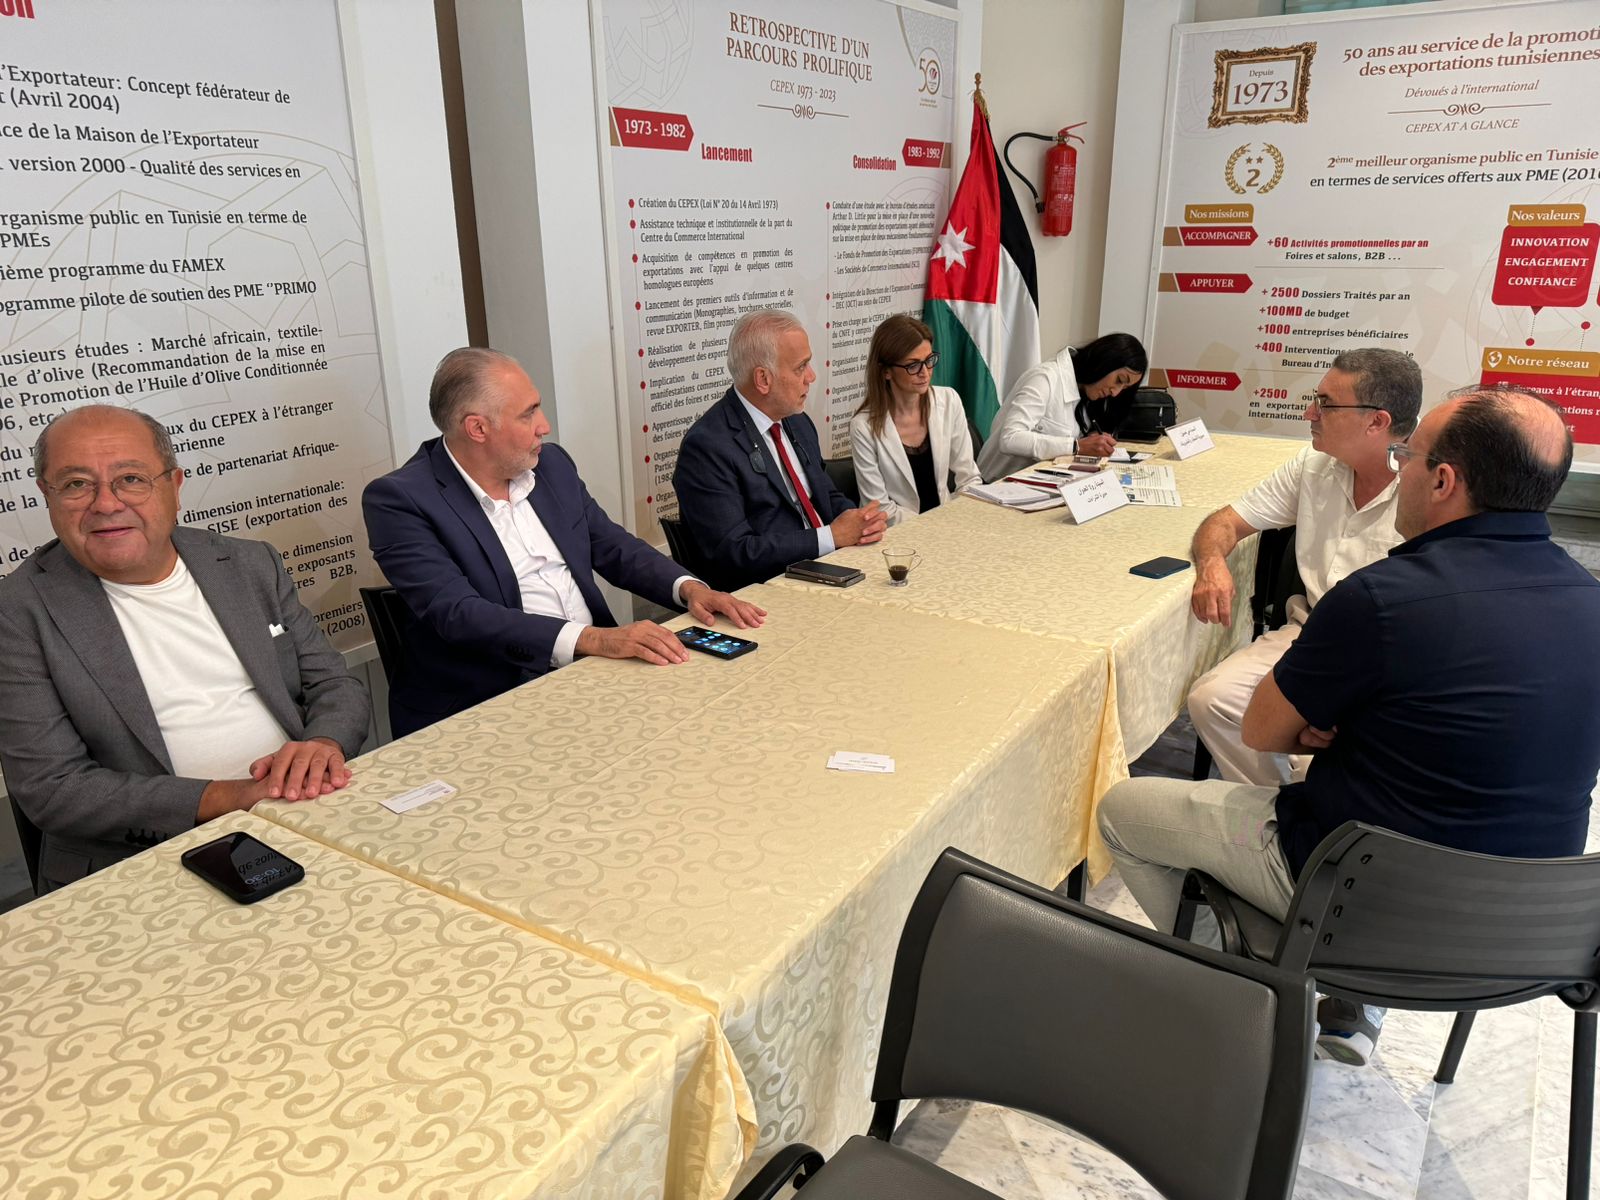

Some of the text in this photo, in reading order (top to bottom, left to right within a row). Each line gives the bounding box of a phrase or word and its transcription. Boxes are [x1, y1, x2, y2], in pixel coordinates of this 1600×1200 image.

[730, 11, 836, 52] RETROSPECTIVE
[1343, 47, 1363, 63] 50
[1367, 46, 1394, 58] ans
[1397, 44, 1417, 55] au
[1420, 36, 1479, 53] service
[1481, 32, 1503, 48] de
[1506, 31, 1522, 47] la
[726, 36, 872, 82] PARCOURS PROLIFIQUE
[1359, 48, 1600, 77] des exportations tunisiennes
[127, 76, 191, 98] Concept
[195, 81, 270, 102] fédérateur
[274, 89, 290, 103] de
[770, 79, 794, 94] CEPEX
[797, 84, 812, 99] 1973
[819, 88, 836, 103] 2023
[1233, 80, 1288, 105] 1973
[1404, 86, 1449, 98] Dévoués
[1450, 84, 1458, 95] à
[10, 86, 63, 108] (Avril
[66, 92, 119, 114] 2004)
[624, 118, 651, 135] 1973
[660, 122, 685, 138] 1982
[1405, 118, 1519, 133] CEPEX AT A GLANCE
[28, 122, 50, 139] de
[53, 123, 71, 140] la
[75, 125, 136, 143] Maison
[140, 128, 159, 144] de
[162, 129, 259, 150] l’Exportateur
[701, 142, 752, 162] Lancement
[907, 146, 923, 157] 1983
[927, 148, 941, 159] 1992
[1355, 155, 1408, 167] meilleur
[1409, 153, 1477, 168] organisme
[1479, 150, 1523, 166] public
[1525, 153, 1542, 161] en
[1546, 148, 1599, 160] Tunisie
[9, 156, 76, 172] version
[80, 157, 125, 173] 2000
[140, 159, 195, 177] Qualité
[199, 161, 223, 175] des
[227, 163, 282, 177] services
[285, 167, 300, 178] en
[852, 154, 896, 170] Consolidation
[1245, 168, 1261, 187] 2
[1310, 178, 1324, 186] en
[1328, 176, 1371, 186] termes
[1373, 173, 1389, 185] de
[1392, 172, 1444, 184] services
[1447, 170, 1493, 183] offerts
[1496, 172, 1522, 182] aux
[1525, 169, 1560, 181] PME
[638, 197, 667, 208] Création
[0, 209, 307, 229] rganisme public en Tunisie en terme de
[1189, 208, 1249, 218] Nos missions
[1511, 209, 1580, 220] Nos valeurs
[0, 232, 50, 248] PMEs
[640, 230, 744, 242] Centre du Commerce International
[1184, 231, 1251, 240] ACCOMPAGNER
[1267, 236, 1288, 247] +60
[1290, 239, 1328, 247] Activités
[1330, 239, 1399, 248] promotionnelles
[1400, 240, 1416, 248] par
[1510, 237, 1589, 246] INNOVATION
[1285, 252, 1313, 260] Foires
[1327, 252, 1361, 261] salons,
[1364, 251, 1385, 260] B2B
[1504, 257, 1589, 266] ENGAGEMENT
[48, 263, 145, 282] programme
[149, 259, 168, 273] du
[171, 257, 225, 273] FAMEX
[1189, 278, 1233, 287] APPUYER
[1507, 276, 1577, 286] CONFIANCE
[1270, 286, 1299, 298] 2500
[1301, 290, 1340, 298] Dossiers
[1343, 290, 1376, 299] Traités
[1378, 293, 1396, 301] par
[1259, 305, 1349, 319] +100MD de budget
[1257, 323, 1408, 339] +1000 entreprises bénéficiaires
[0, 349, 66, 366] usieurs
[75, 341, 129, 358] études
[151, 333, 206, 351] Marché
[213, 329, 270, 345] africain,
[277, 324, 322, 339] textile-
[1255, 341, 1282, 352] +400
[1281, 358, 1312, 367] Bureau
[1506, 355, 1589, 368] Notre réseau
[1176, 374, 1226, 385] INFORMER
[1253, 387, 1287, 399] +2500
[196, 442, 338, 476] de partenariat Afrique-
[183, 480, 344, 523] dimension internationale:
[207, 496, 347, 533] SISE (exportation des
